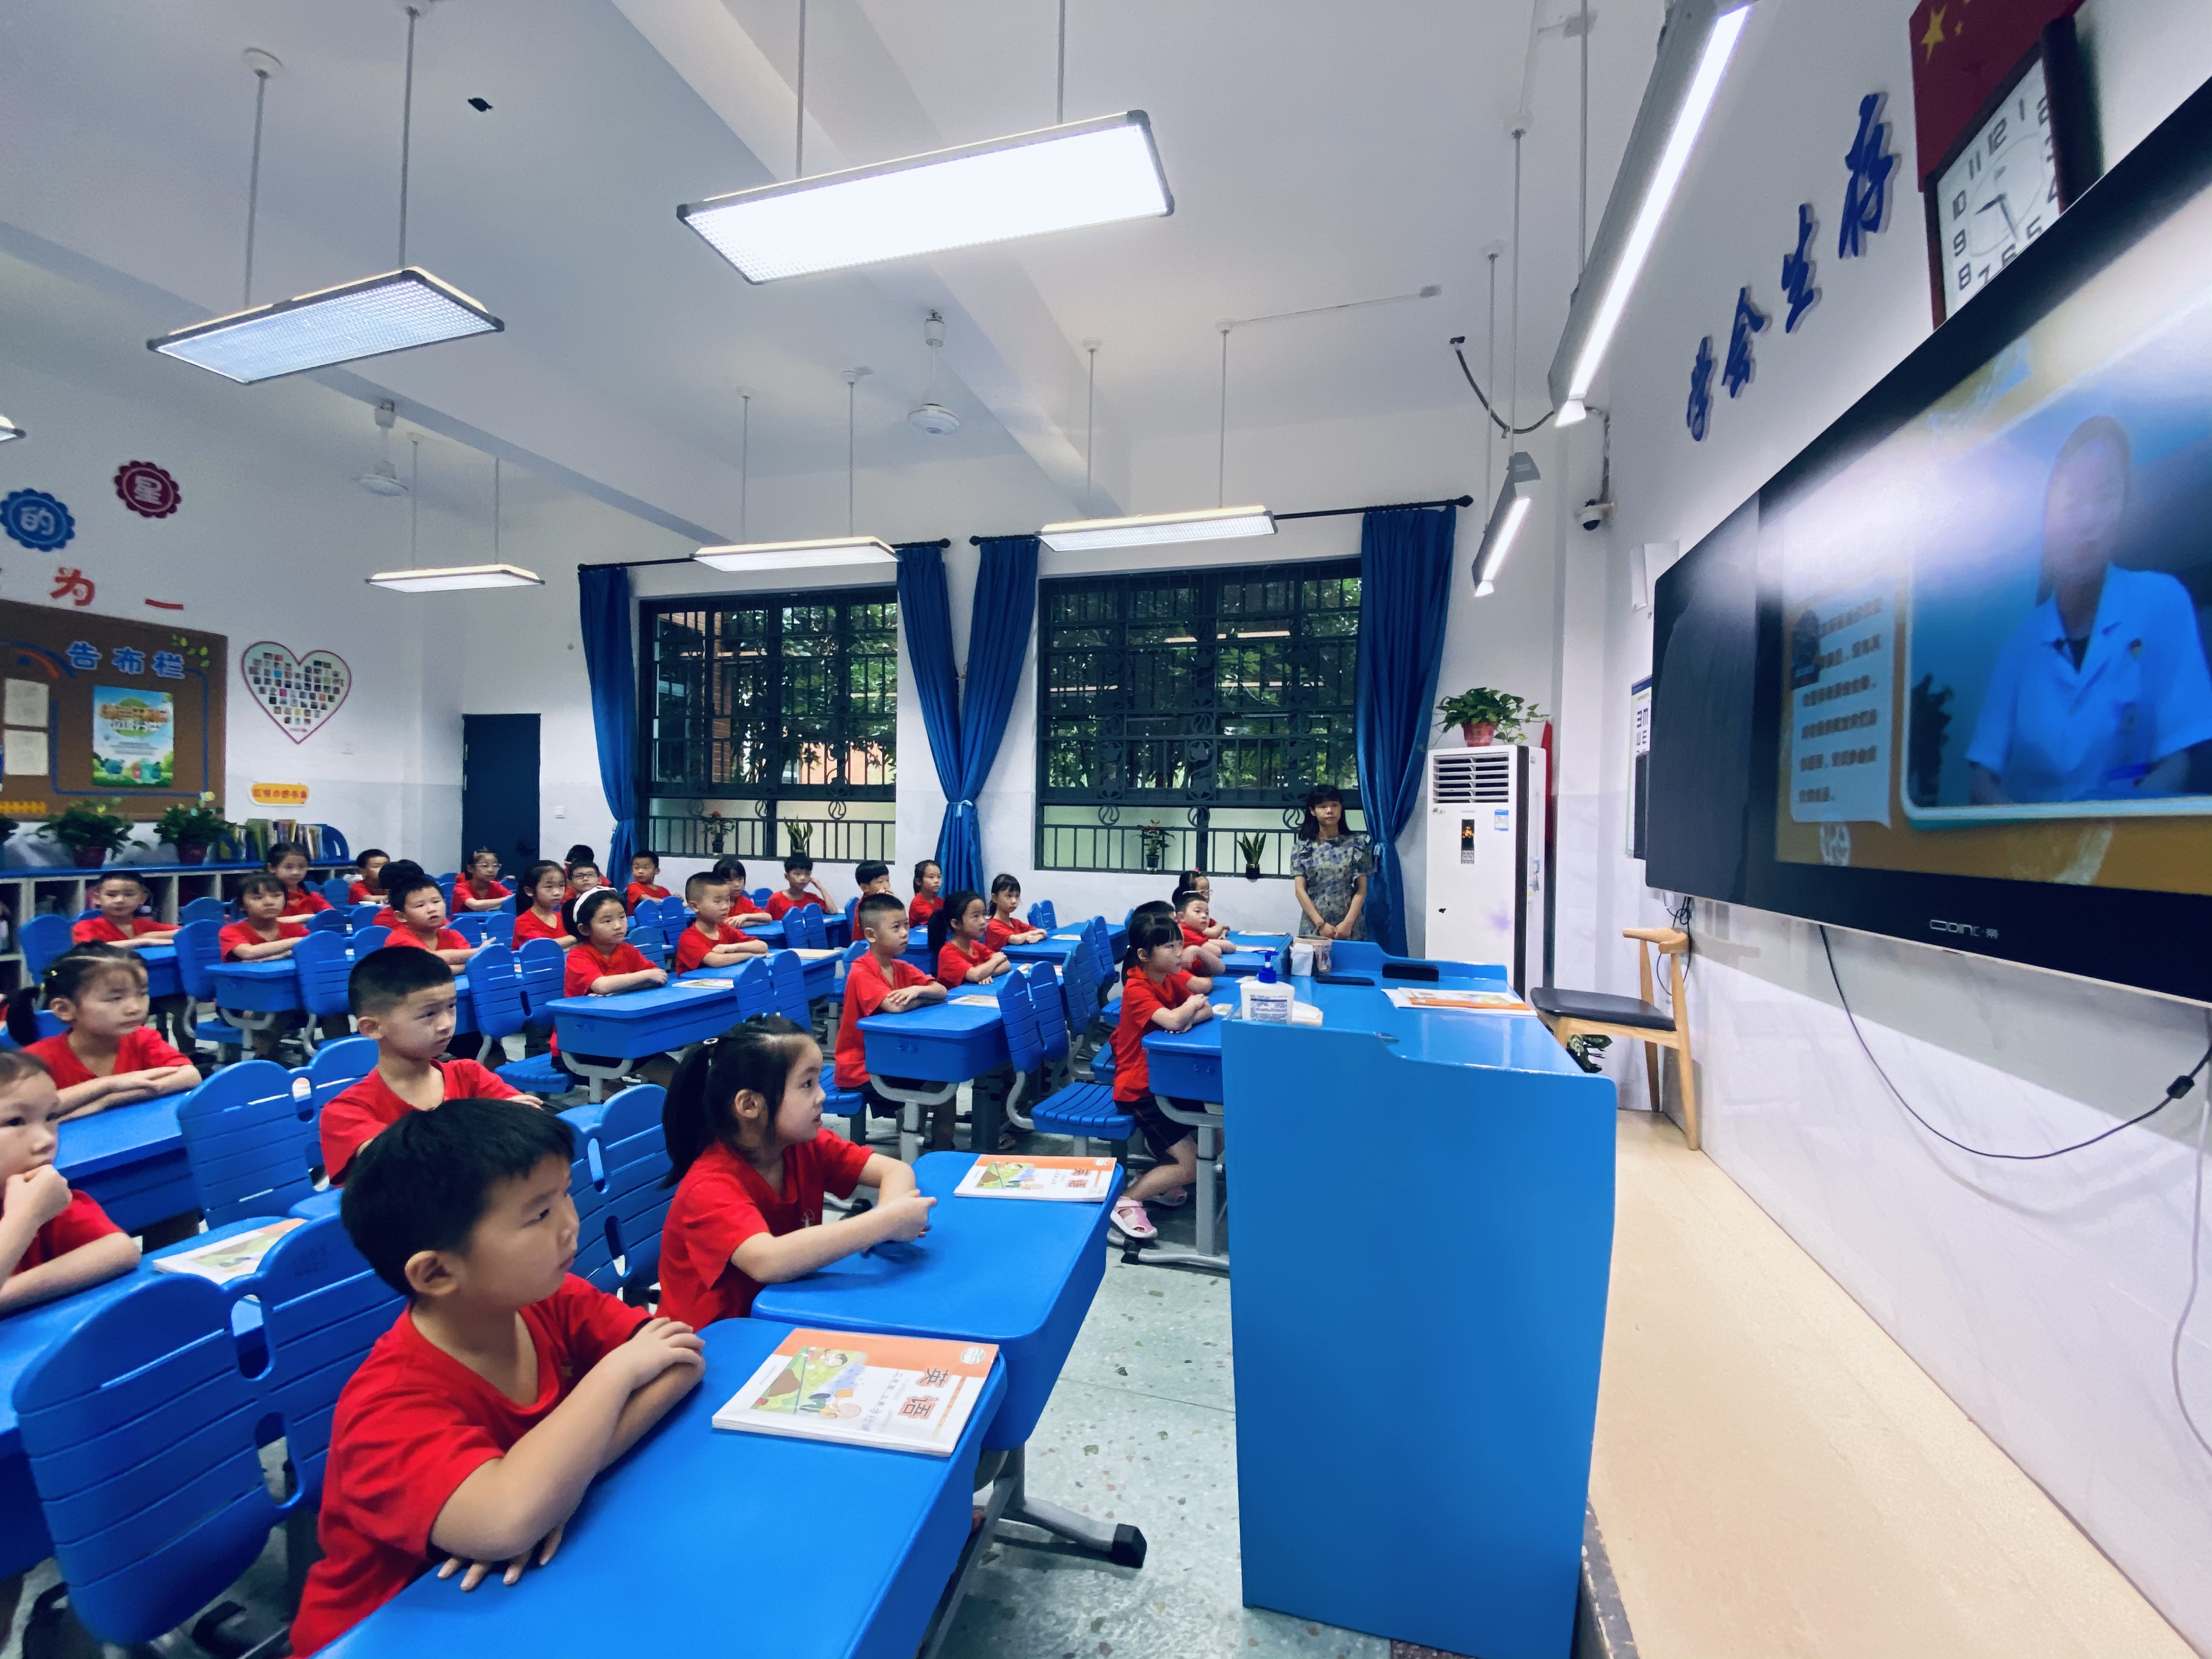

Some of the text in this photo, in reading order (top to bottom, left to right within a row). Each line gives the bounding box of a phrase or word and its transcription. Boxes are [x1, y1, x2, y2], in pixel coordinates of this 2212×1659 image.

[2018, 98, 2025, 122] 1
[1987, 117, 2007, 156] 12
[1968, 150, 1982, 181] 11
[1953, 189, 1967, 221] 10
[2026, 215, 2042, 240] 5
[1953, 229, 1966, 257] 9
[1959, 262, 1971, 290] 8
[901, 1368, 950, 1417] 英语
